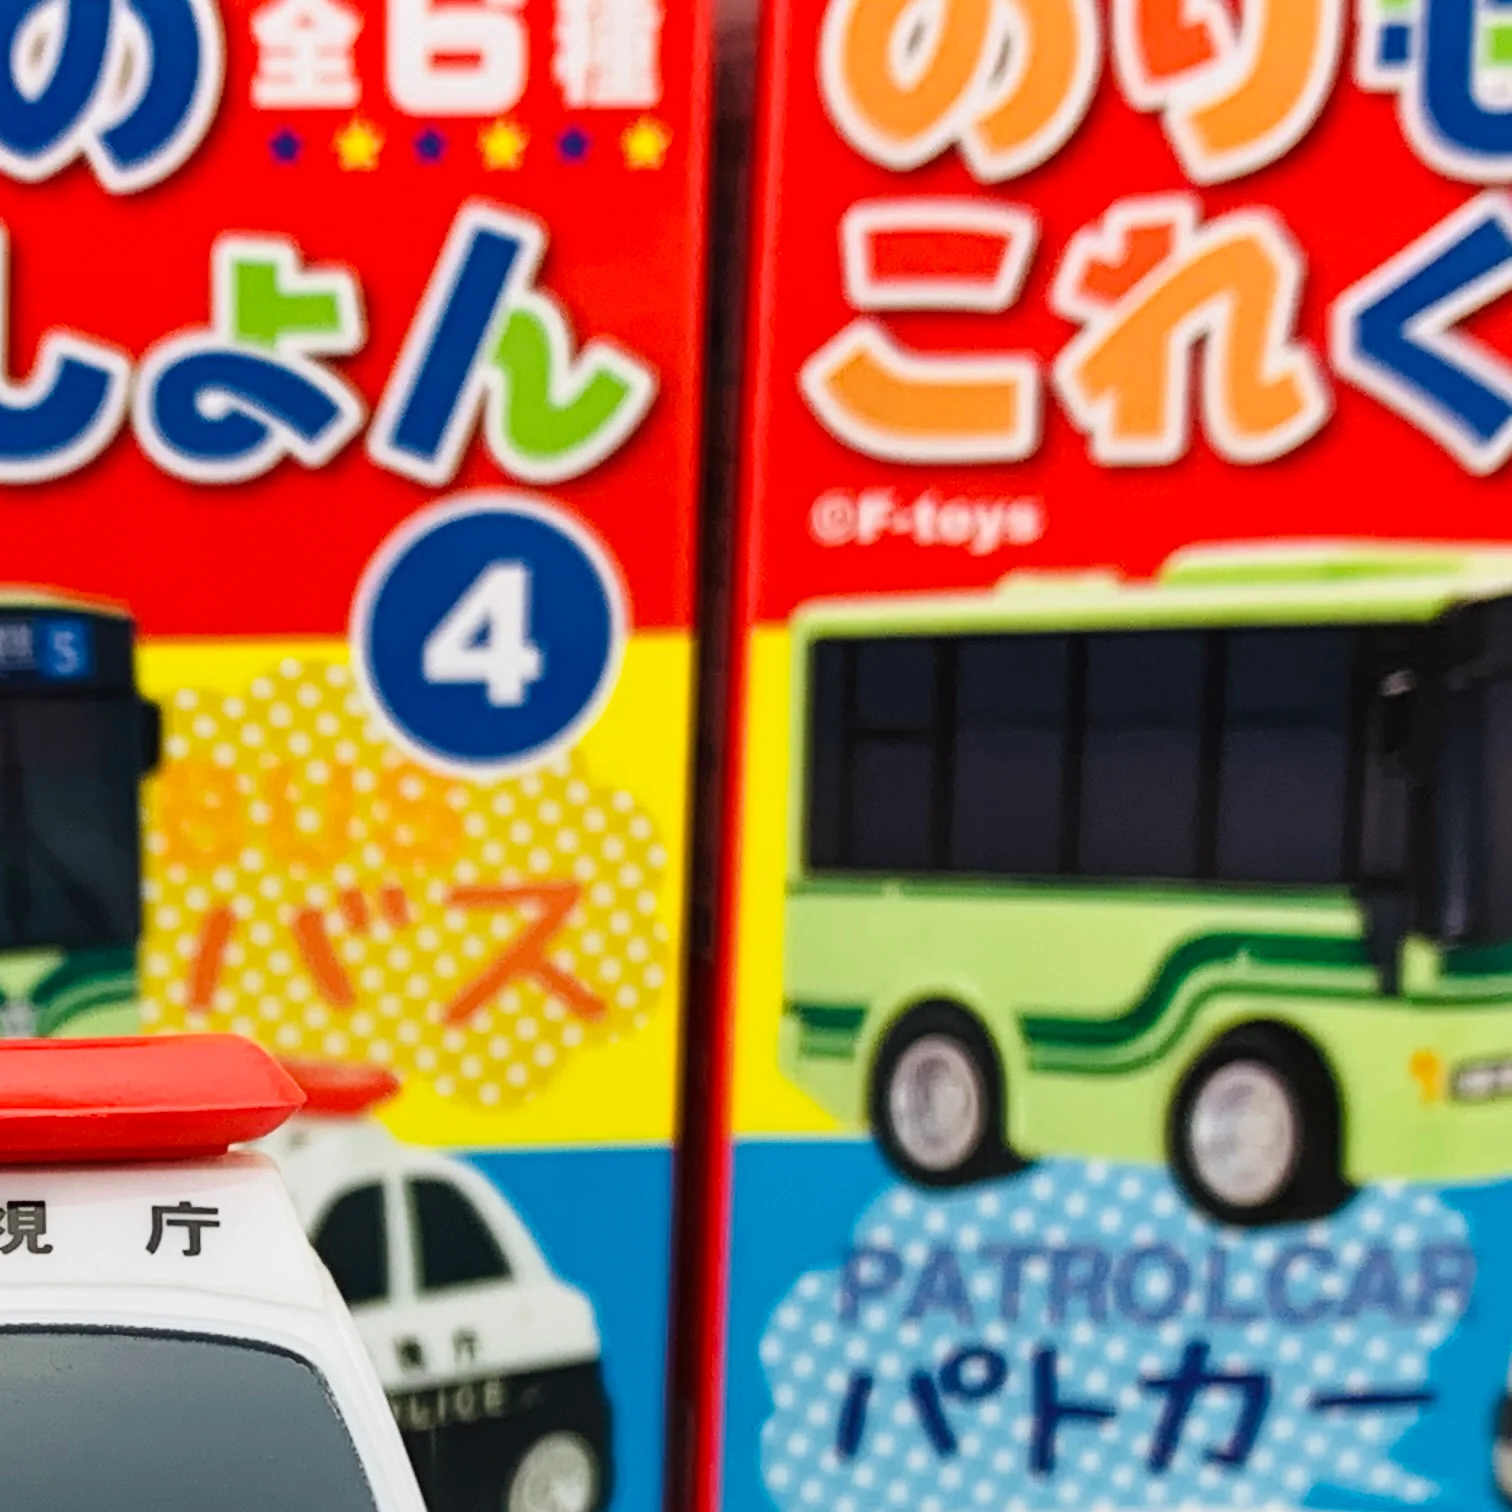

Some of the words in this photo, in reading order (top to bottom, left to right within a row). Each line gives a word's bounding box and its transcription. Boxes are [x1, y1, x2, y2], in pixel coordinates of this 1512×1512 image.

[422, 561, 543, 707] 4
[188, 882, 608, 1028] バス
[834, 1340, 1438, 1478] パトカー
